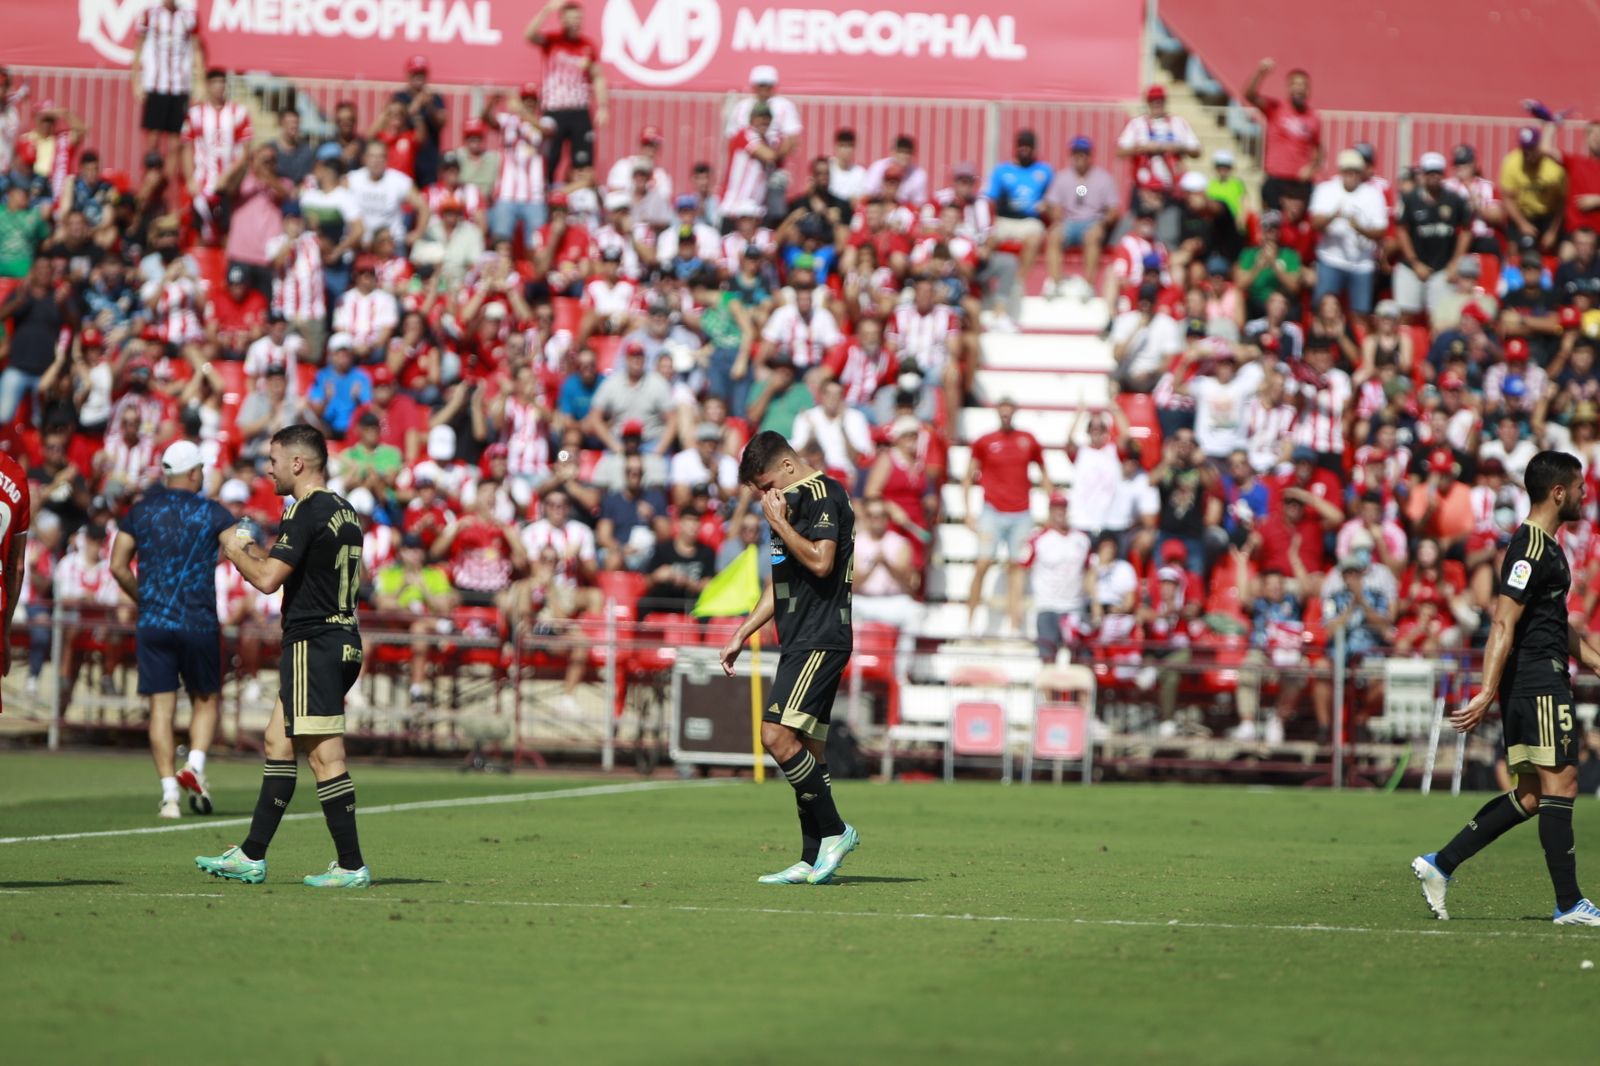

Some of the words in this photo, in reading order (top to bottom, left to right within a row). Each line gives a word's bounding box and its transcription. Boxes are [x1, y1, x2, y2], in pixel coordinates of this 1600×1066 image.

[208, 0, 502, 45] MERCOPHAL
[731, 7, 1027, 60] MERCOPHAL
[334, 544, 361, 611] 17
[1558, 704, 1573, 732] 5
